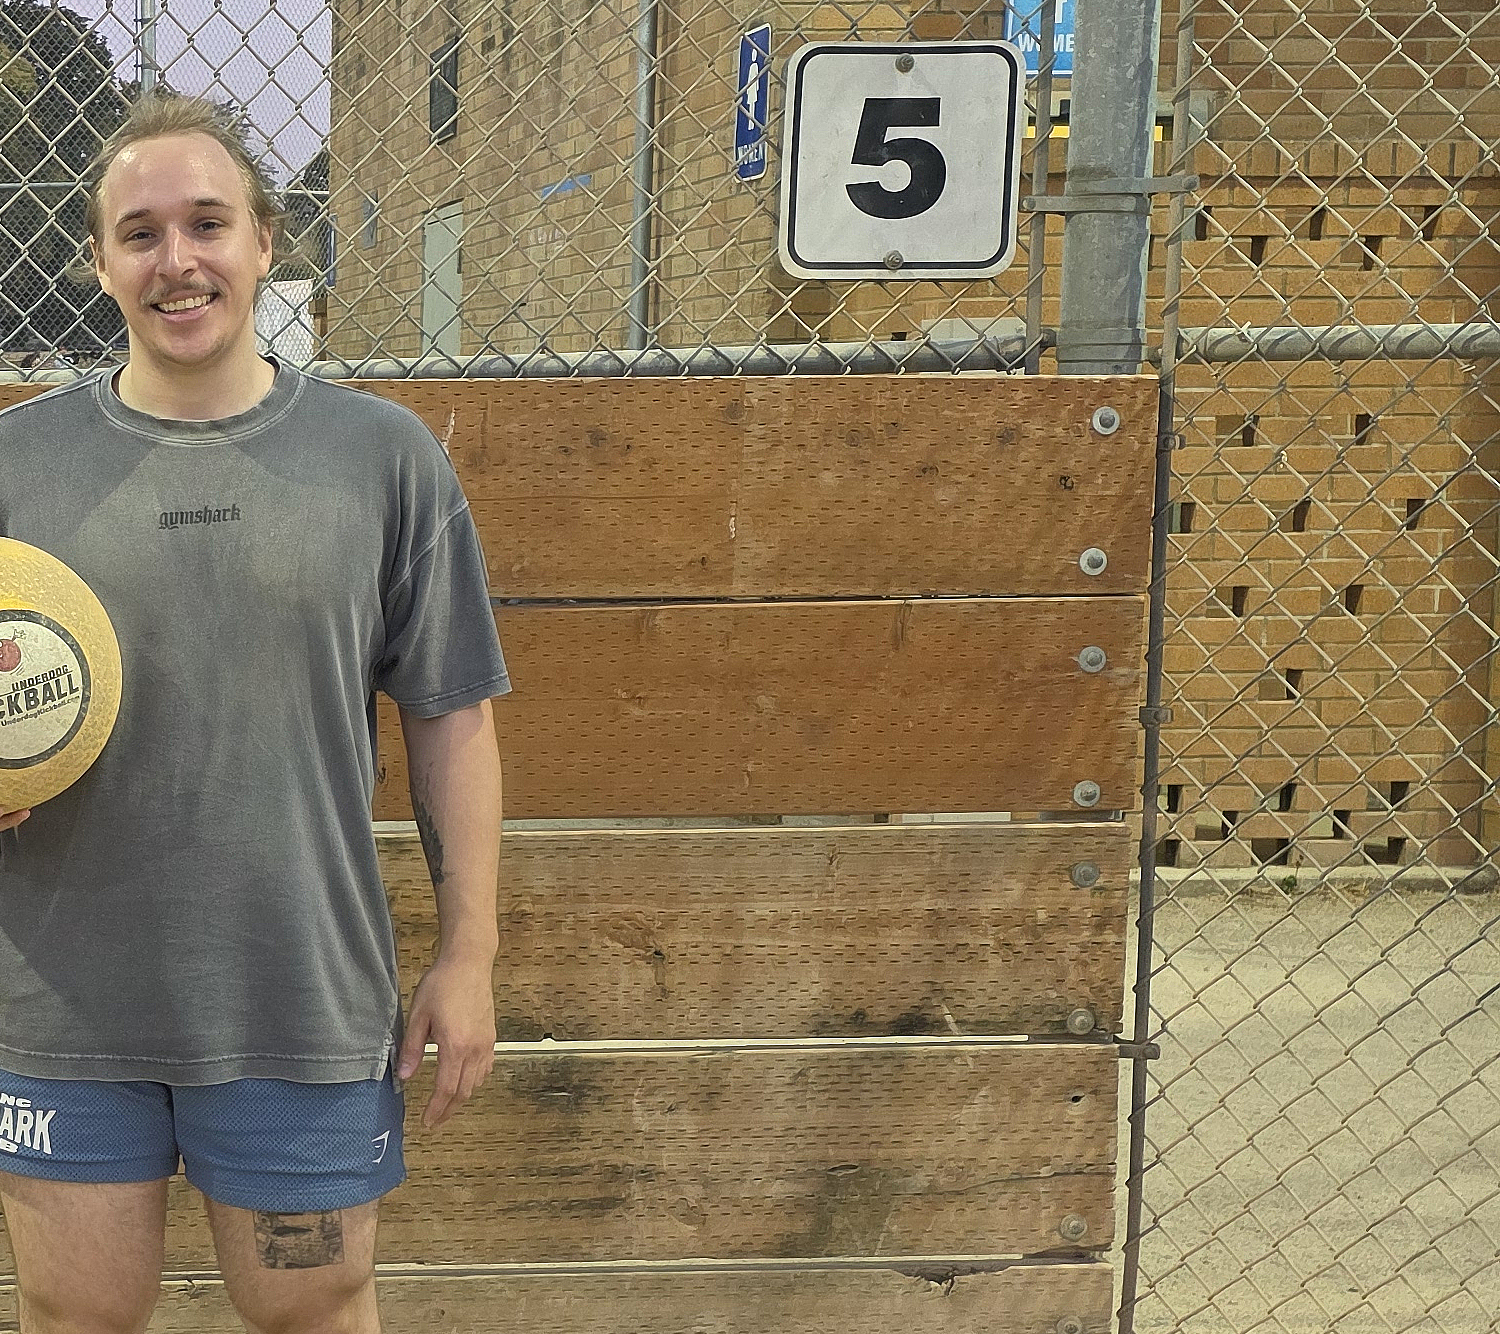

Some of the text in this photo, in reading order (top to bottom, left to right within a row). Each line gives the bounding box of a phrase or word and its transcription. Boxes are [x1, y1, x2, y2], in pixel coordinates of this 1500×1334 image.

[1017, 33, 1074, 53] WME
[845, 97, 947, 219] 5
[158, 503, 242, 530] gymshark
[11, 664, 70, 693] UNDERDOG
